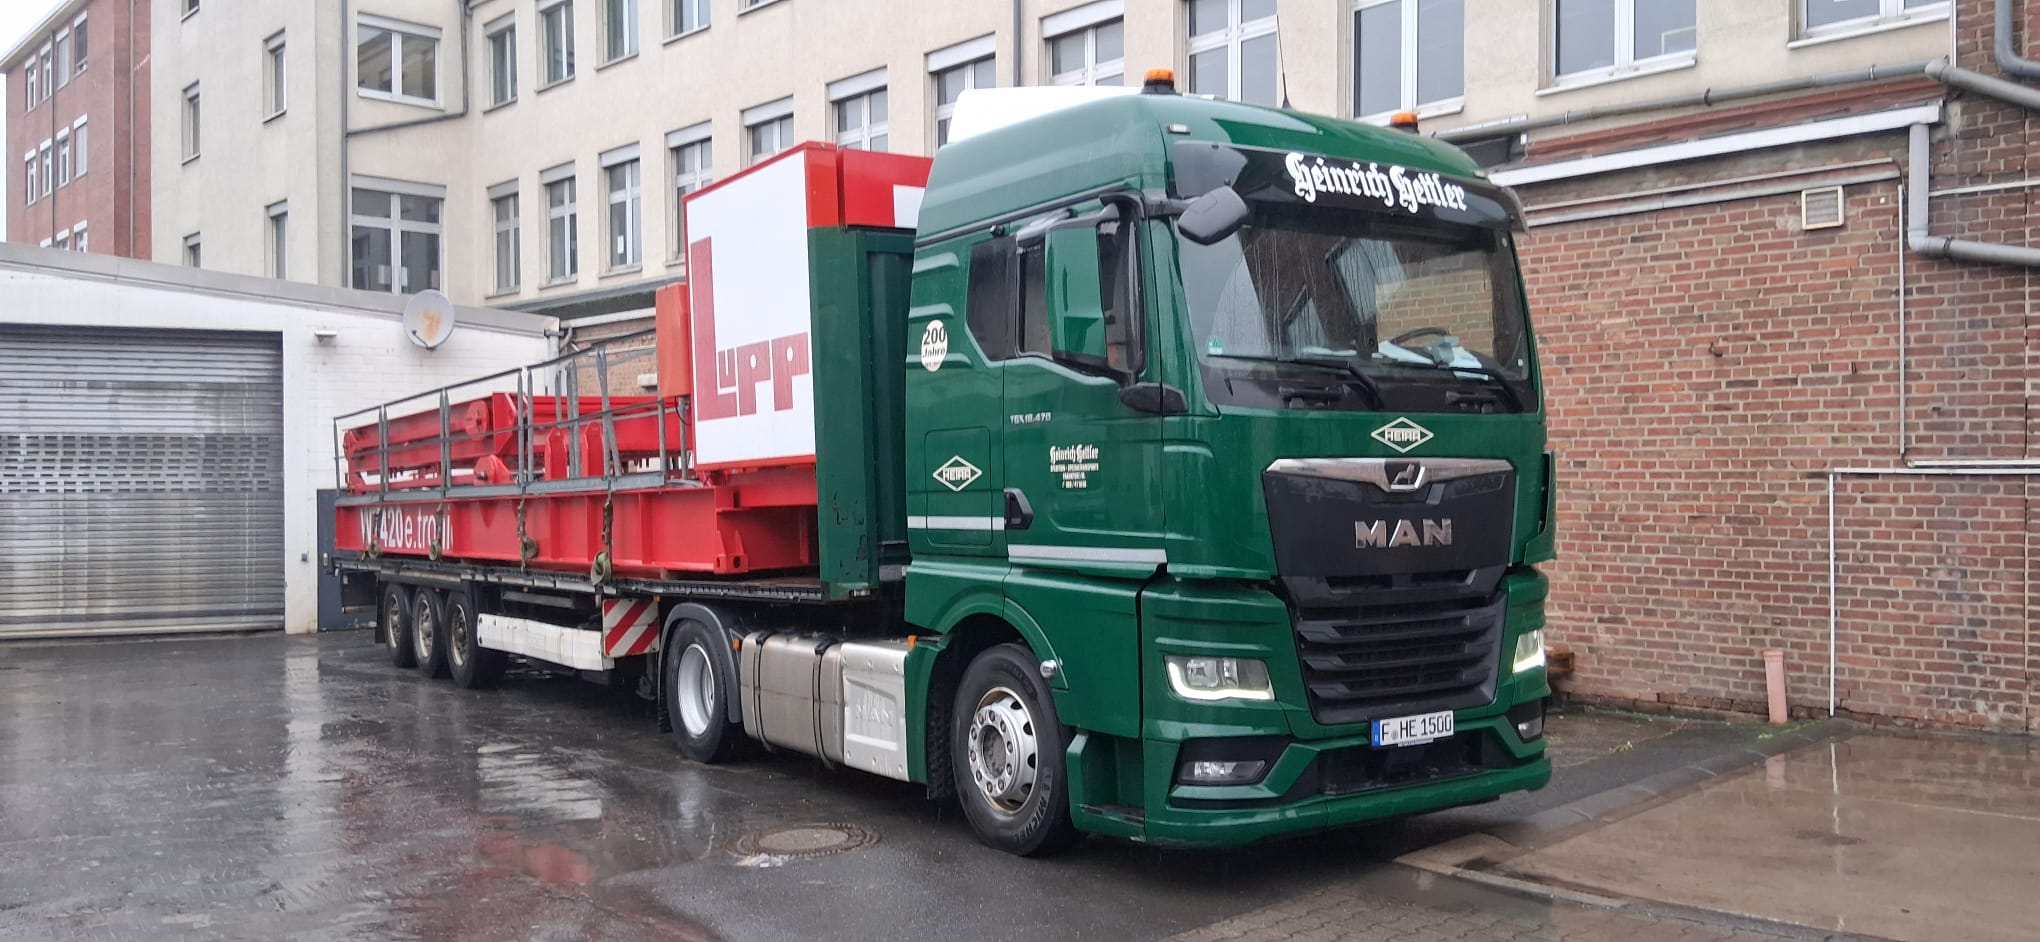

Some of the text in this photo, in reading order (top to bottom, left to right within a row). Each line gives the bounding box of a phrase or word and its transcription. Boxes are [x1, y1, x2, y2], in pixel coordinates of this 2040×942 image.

[1285, 152, 1468, 214] Heinrich Hettler
[923, 327, 946, 345] 200
[923, 346, 946, 359] Jahre
[1355, 518, 1452, 548] MAN
[1381, 714, 1452, 742] F HE 1500
